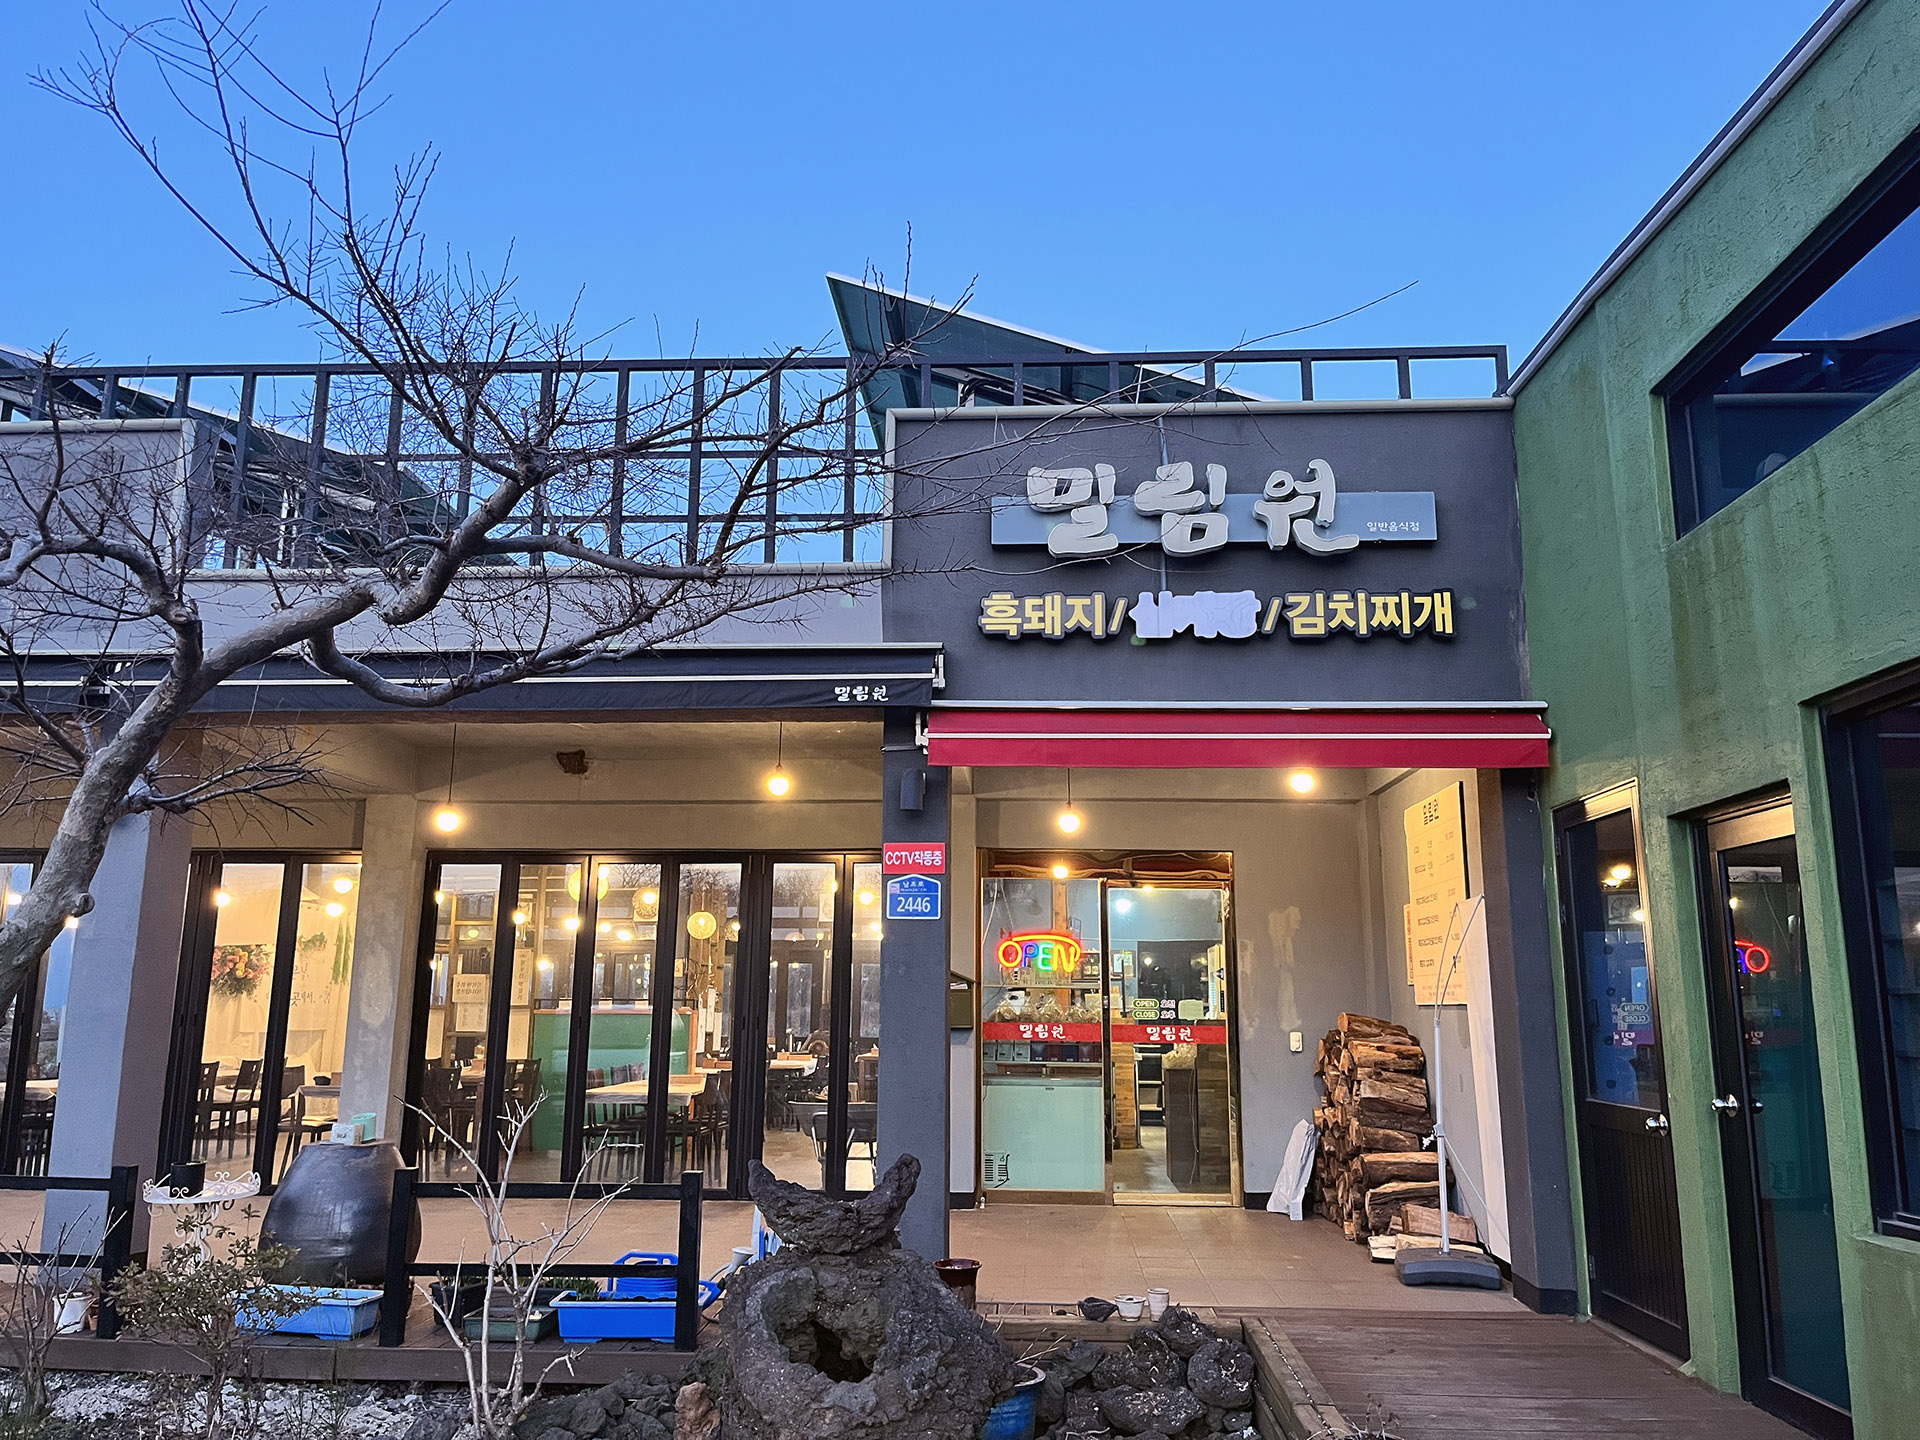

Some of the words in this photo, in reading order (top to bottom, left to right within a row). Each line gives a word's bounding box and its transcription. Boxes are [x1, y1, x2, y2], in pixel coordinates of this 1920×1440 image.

[1027, 459, 1359, 557] 밀림원
[1366, 521, 1420, 532] 일반음식점
[834, 685, 889, 702] 밀림원
[885, 850, 943, 866] CCTV작동중
[896, 897, 931, 913] 2446
[998, 940, 1077, 974] OPEN
[1019, 1024, 1066, 1039] 밀림원
[1146, 1026, 1194, 1042] 밀림원
